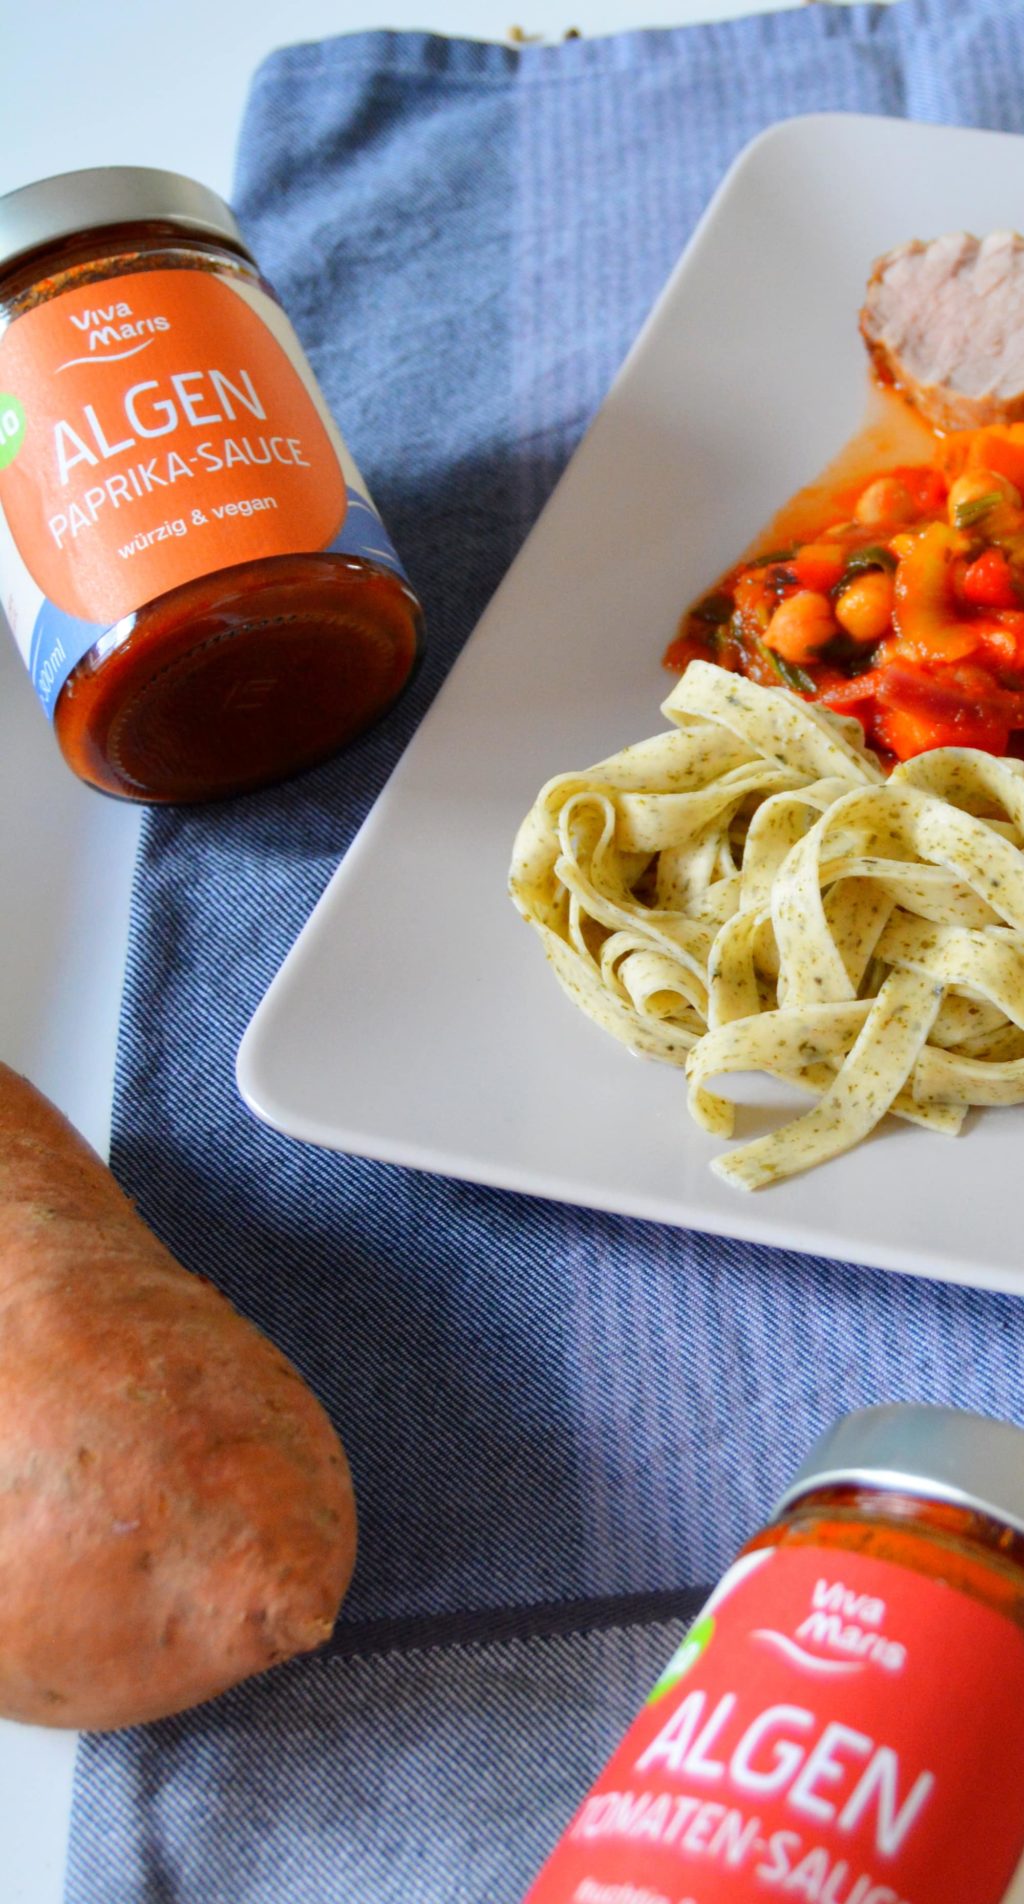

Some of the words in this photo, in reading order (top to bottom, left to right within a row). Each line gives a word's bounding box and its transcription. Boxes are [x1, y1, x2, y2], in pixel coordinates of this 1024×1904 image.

[70, 301, 133, 331] Viva
[89, 315, 170, 350] Maris
[54, 369, 267, 486] ALGEN
[48, 437, 310, 549] PAPRIKA-SAUCE
[118, 518, 187, 560] würzig
[191, 509, 208, 527] &
[212, 496, 277, 521] vegan
[812, 1578, 886, 1625] Viva
[794, 1611, 908, 1670] Maris
[634, 1689, 935, 1857] ALGEN
